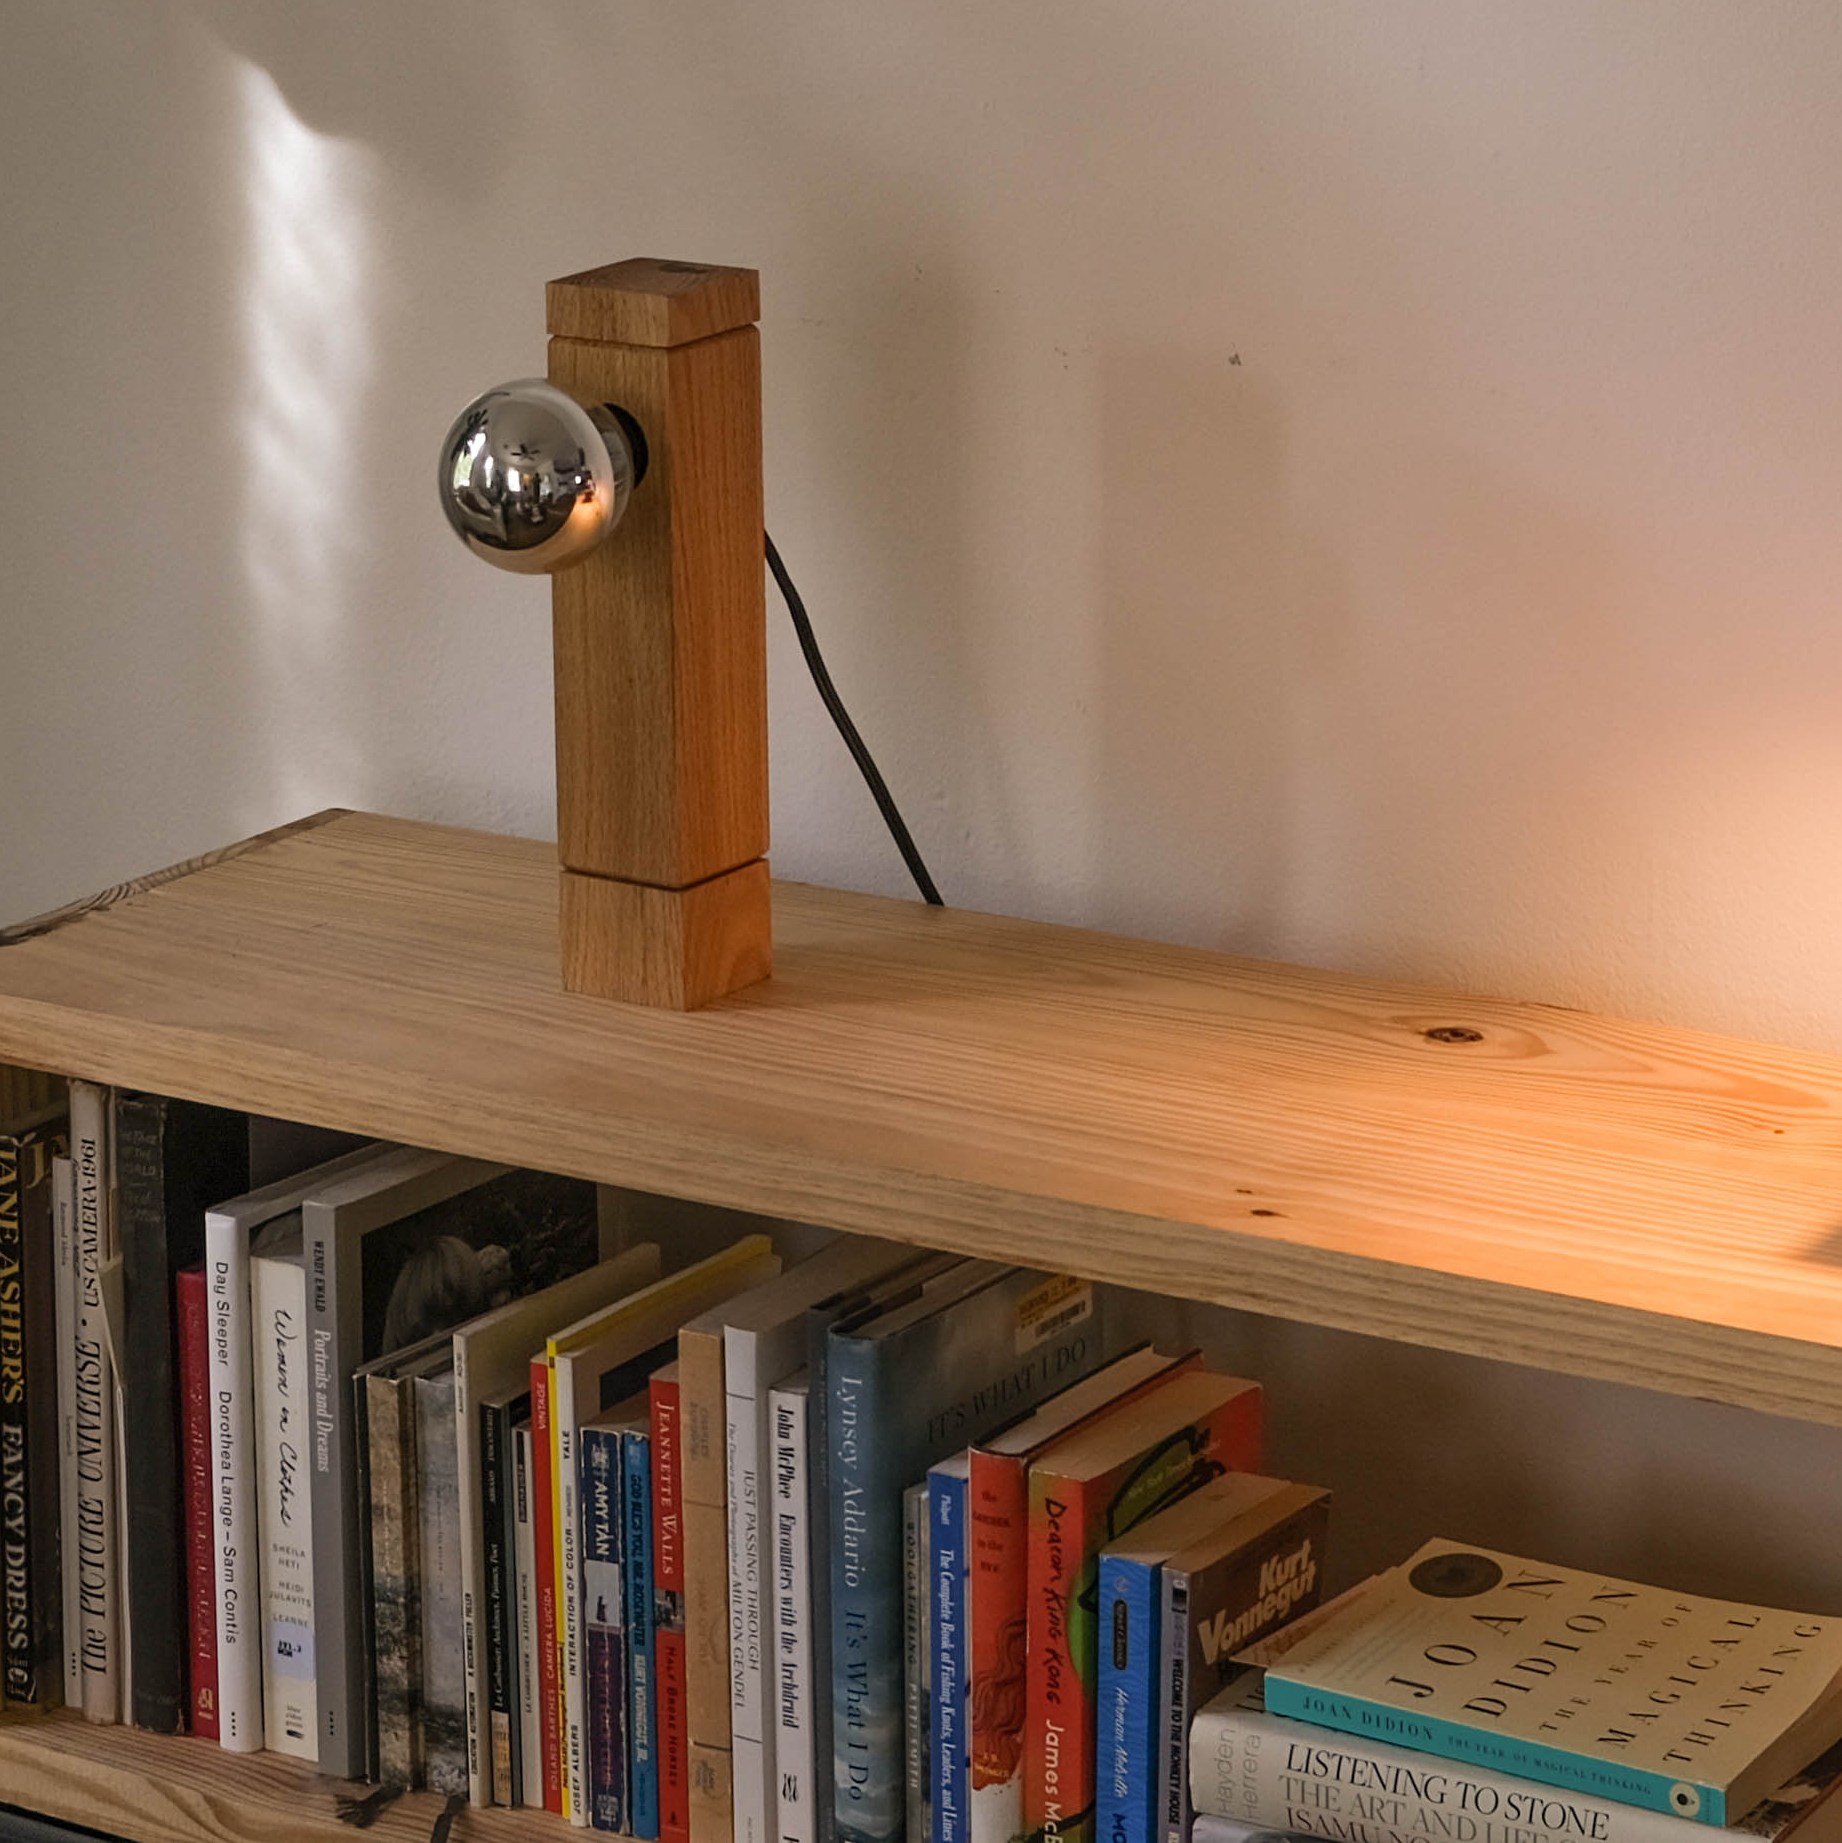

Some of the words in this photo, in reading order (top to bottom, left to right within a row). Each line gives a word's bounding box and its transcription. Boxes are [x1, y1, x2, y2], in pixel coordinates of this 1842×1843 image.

[214, 1261, 228, 1294] Day
[313, 1241, 325, 1274] WENDY
[84, 1278, 99, 1307] US
[314, 1277, 326, 1312] EWALD
[0, 1252, 24, 1403] ASHER'S
[216, 1300, 230, 1366] Sleeper
[314, 1329, 331, 1389] Portraits
[76, 1335, 102, 1482] UNIVERSE
[316, 1394, 332, 1417] and
[538, 1382, 546, 1430] VINTAGE
[927, 1404, 966, 1444] IT'S
[972, 1362, 1036, 1416] WHAT
[1057, 1337, 1086, 1374] DO
[218, 1391, 234, 1470] Dorothea
[316, 1417, 334, 1473] Dreams
[777, 1404, 794, 1439] John
[836, 1376, 862, 1470] Lynsey
[656, 1401, 675, 1507] JEANNETTE
[777, 1445, 796, 1499] McPhee
[2, 1424, 26, 1538] FANCY
[220, 1476, 235, 1527] Lange
[278, 1441, 297, 1528] Clothes
[594, 1480, 608, 1519] AMY
[630, 1474, 642, 1499] GOD
[743, 1470, 755, 1508] JUST
[596, 1523, 610, 1555] TAN
[631, 1501, 643, 1530] BLESS
[843, 1478, 866, 1587] Addario
[1044, 1497, 1067, 1582] Deacon
[79, 1498, 106, 1617] PICTURE
[223, 1546, 237, 1577] Sam
[272, 1543, 306, 1559] SHEILA
[278, 1558, 300, 1571] HETI
[563, 1528, 574, 1567] COLOR
[660, 1513, 677, 1575] WALLS
[744, 1512, 757, 1582] PASSING
[778, 1513, 796, 1590] Encounters
[940, 1549, 955, 1568] The
[1258, 1538, 1311, 1598] Kurt
[6, 1543, 29, 1650] DRESS
[278, 1581, 304, 1594] HEIDI
[566, 1574, 575, 1589] OF
[907, 1522, 918, 1664] WOOLGATHERING
[938, 1572, 955, 1620] Complete
[224, 1589, 239, 1644] Contis
[543, 1587, 553, 1632] LUCIDA
[633, 1582, 645, 1646] ROSEWATER
[732, 1581, 743, 1641] MILTON
[747, 1588, 759, 1671] THROUGH
[780, 1595, 797, 1626] with
[845, 1610, 868, 1649] It's
[1196, 1560, 1317, 1666] Vonnegut
[1385, 1569, 1567, 1699] JOAN
[82, 1629, 106, 1674] The
[545, 1635, 555, 1679] CAMERA
[567, 1596, 577, 1676] INTERACTION
[780, 1631, 798, 1654] the
[940, 1622, 955, 1649] Book
[941, 1652, 955, 1664] of
[1461, 1584, 1639, 1719] DIDION
[635, 1654, 645, 1684] KURT
[666, 1646, 675, 1680] HALF
[733, 1646, 745, 1709] GENDEL
[939, 1664, 956, 1703] Fishing
[1172, 1658, 1184, 1708] WELCOME
[1539, 1695, 1591, 1732] THE
[1593, 1638, 1658, 1685] YEAR
[1661, 1602, 1692, 1628] OF
[1596, 1615, 1761, 1751] MAGICAL
[547, 1688, 556, 1738] BARTHES
[668, 1685, 678, 1730] BROKE
[781, 1662, 799, 1729] Archdruid
[846, 1662, 869, 1729] What
[908, 1683, 917, 1729] PATTI
[1114, 1687, 1130, 1744] Herman
[1171, 1709, 1183, 1723] TO
[1662, 1623, 1822, 1763] THINKING
[848, 1742, 868, 1751] I
[941, 1706, 956, 1740] Knots,
[1171, 1724, 1183, 1742] THE
[1303, 1696, 1353, 1721] JOAN
[1361, 1711, 1435, 1741] DIDION
[1447, 1736, 1470, 1750] THE
[1474, 1741, 1505, 1759] YEAR
[1511, 1750, 1528, 1764] OF
[1534, 1756, 1587, 1780] MAGICAL
[1590, 1770, 1653, 1796] THINKING
[549, 1742, 559, 1791] ROLAND
[570, 1725, 580, 1772] ALBERS
[668, 1735, 678, 1786] HORSES
[909, 1737, 919, 1789] SMITH
[941, 1742, 957, 1787] Leaders,
[1044, 1718, 1065, 1795] James
[1113, 1745, 1130, 1799] Melville
[1170, 1744, 1182, 1789] MONKEY
[1214, 1727, 1237, 1814] Hayden
[571, 1776, 581, 1815] JOSEF
[848, 1764, 869, 1801] Do
[942, 1789, 957, 1809] and
[1241, 1734, 1261, 1820] Herrera
[1286, 1742, 1448, 1805] LISTENING
[1454, 1780, 1500, 1816] TO
[1504, 1791, 1611, 1842] STONE
[942, 1811, 957, 1842] Lines
[1168, 1790, 1182, 1825] HOUSE
[1278, 1774, 1342, 1813] THE
[1347, 1792, 1408, 1827] ART
[1411, 1806, 1478, 1842] AND
